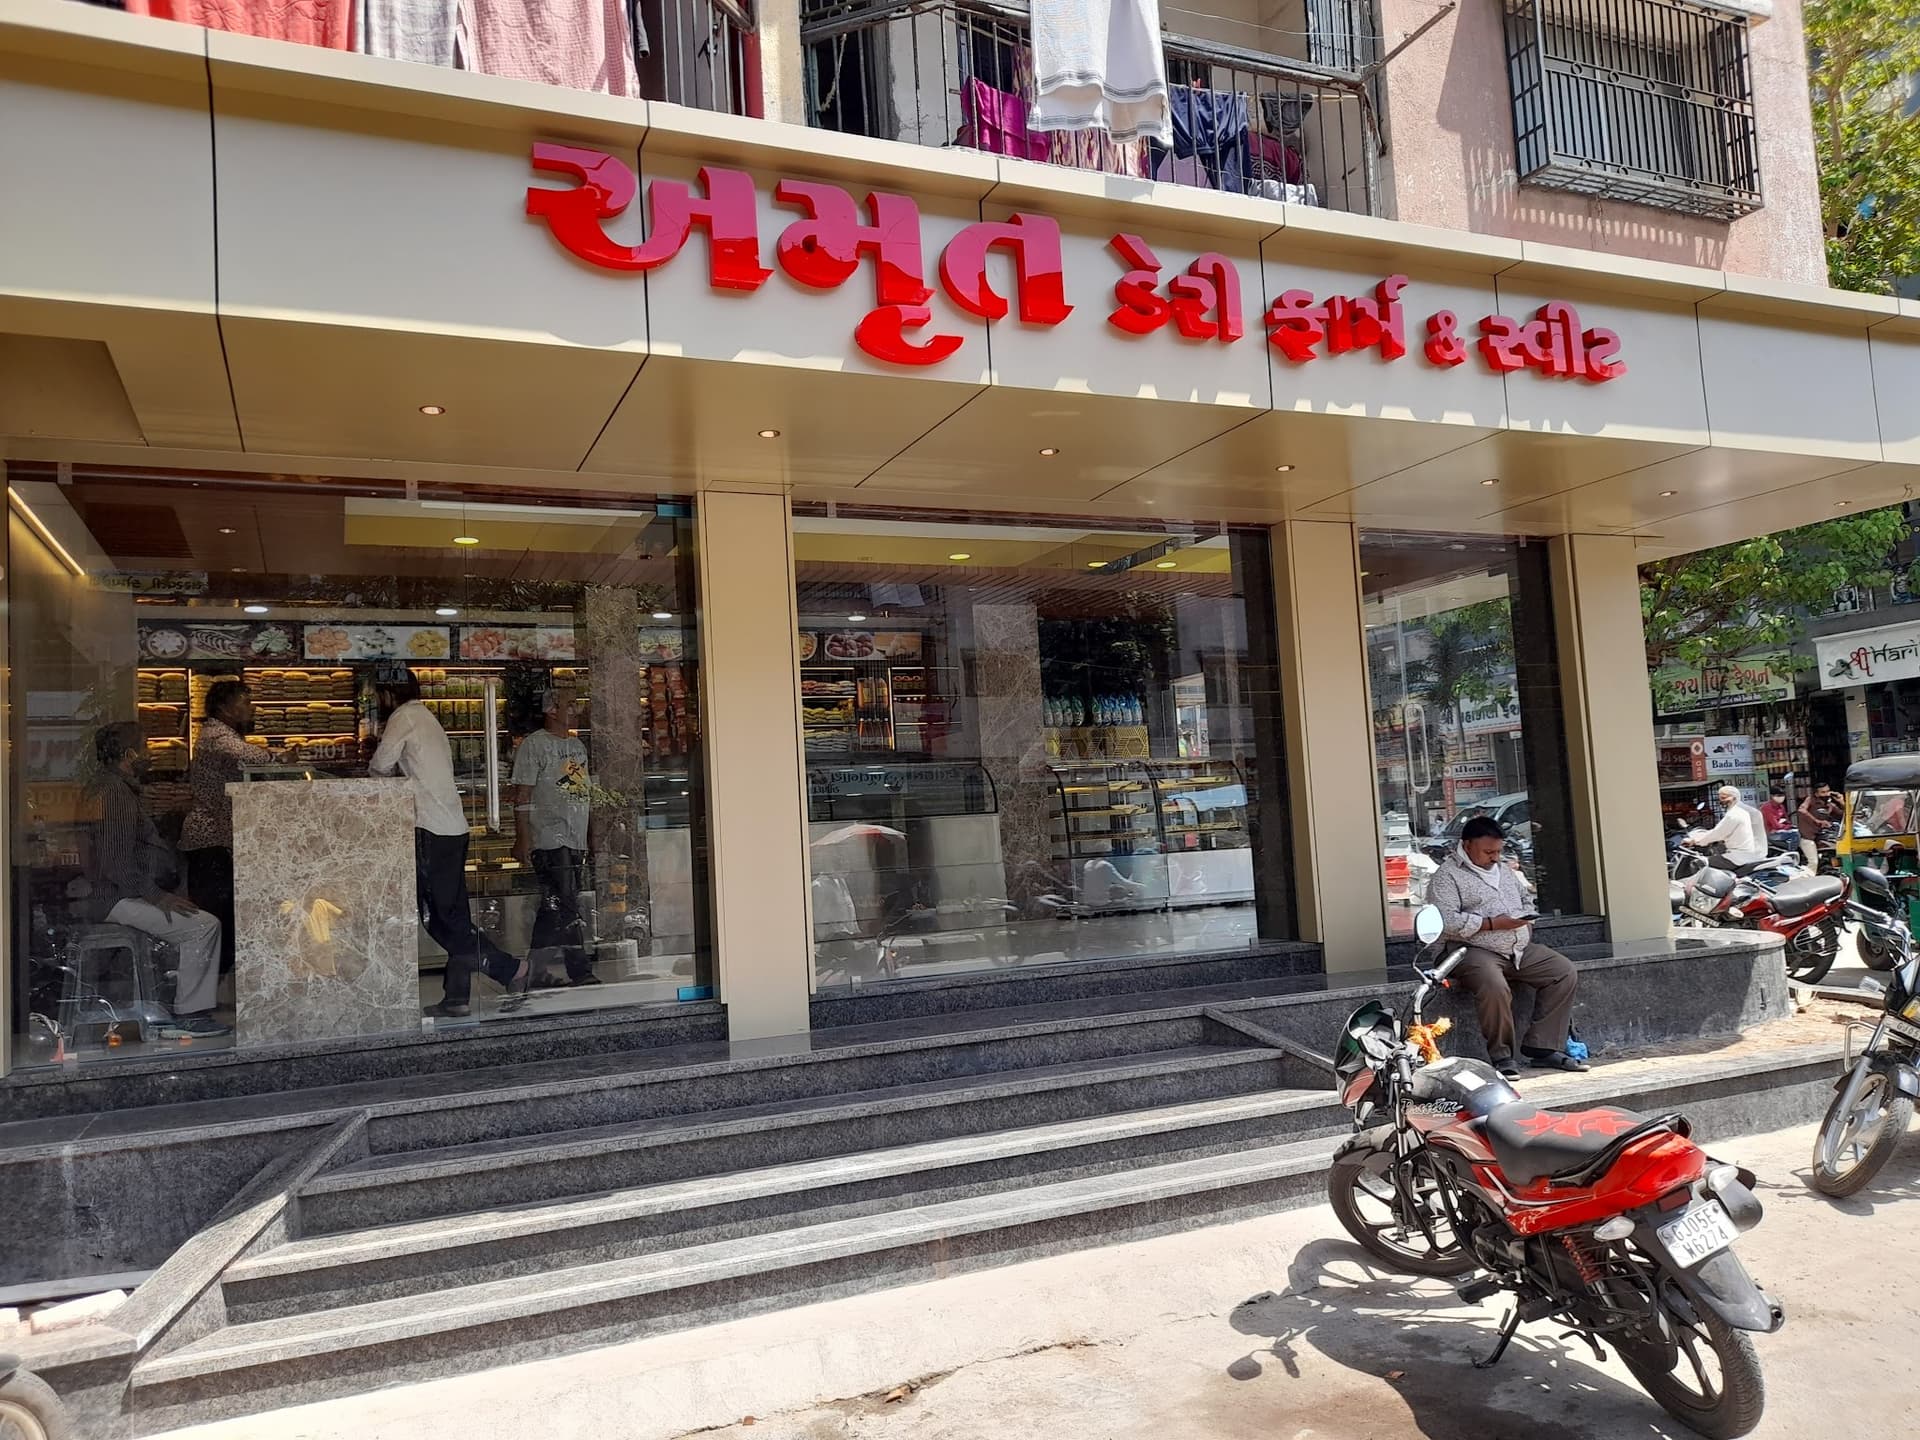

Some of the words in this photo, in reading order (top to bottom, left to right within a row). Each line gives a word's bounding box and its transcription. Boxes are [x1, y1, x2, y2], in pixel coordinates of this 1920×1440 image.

[526, 142, 1075, 366] અમૃત
[1107, 233, 1243, 342] ડેરી
[1264, 274, 1408, 362] ફાર્મ
[1425, 309, 1468, 367] &
[1478, 300, 1629, 384] સ્વીટ
[1671, 1207, 1717, 1242] GJ05E
